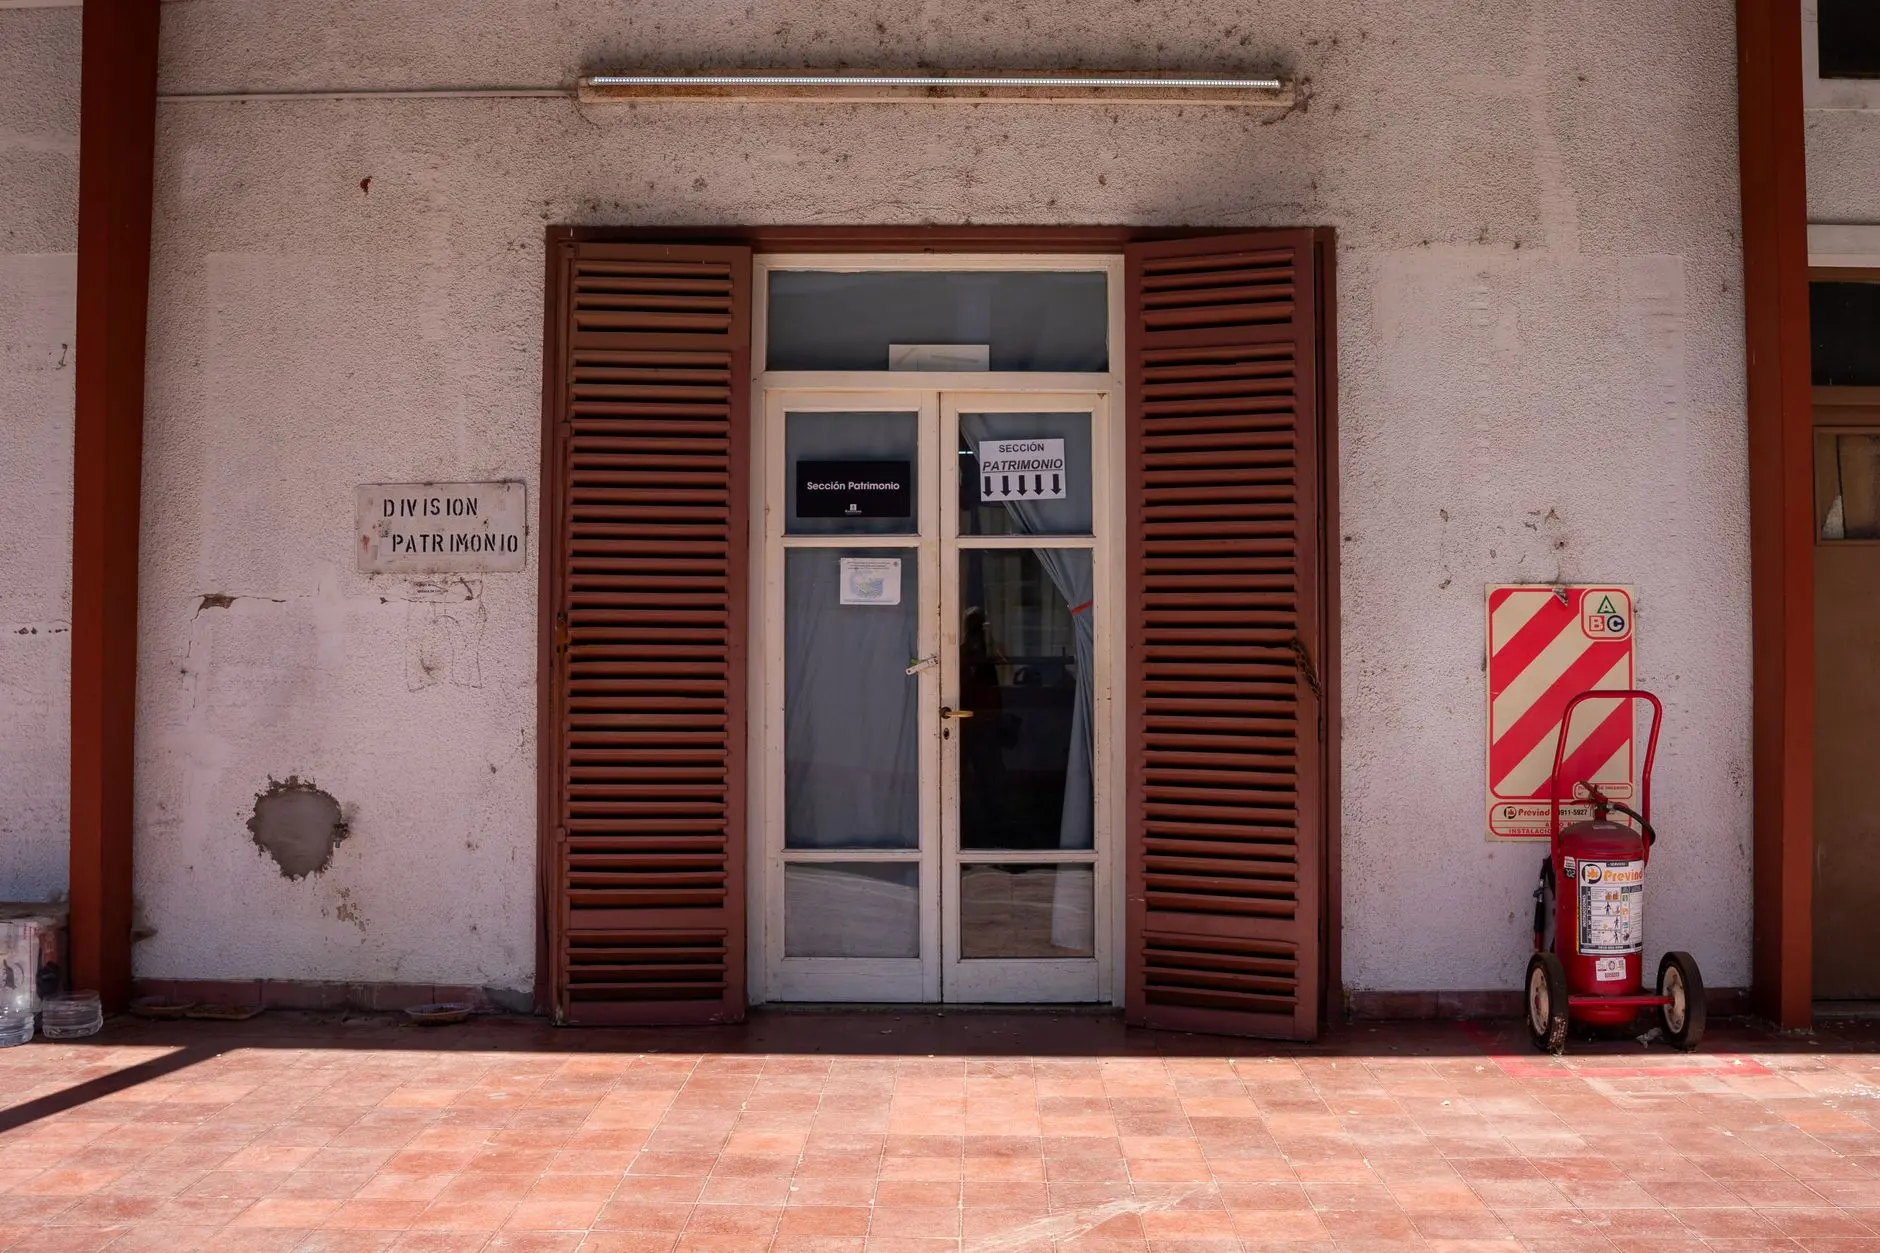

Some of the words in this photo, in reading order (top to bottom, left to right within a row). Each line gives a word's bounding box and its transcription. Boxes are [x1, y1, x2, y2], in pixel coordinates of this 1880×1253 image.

[999, 442, 1045, 453] SECCIÓN
[983, 459, 1063, 472] PATRIMONIO
[807, 481, 846, 490] Sección
[848, 481, 900, 490] Patrimonio
[383, 498, 478, 517] DIVISION
[392, 534, 518, 552] PATRIMONIO
